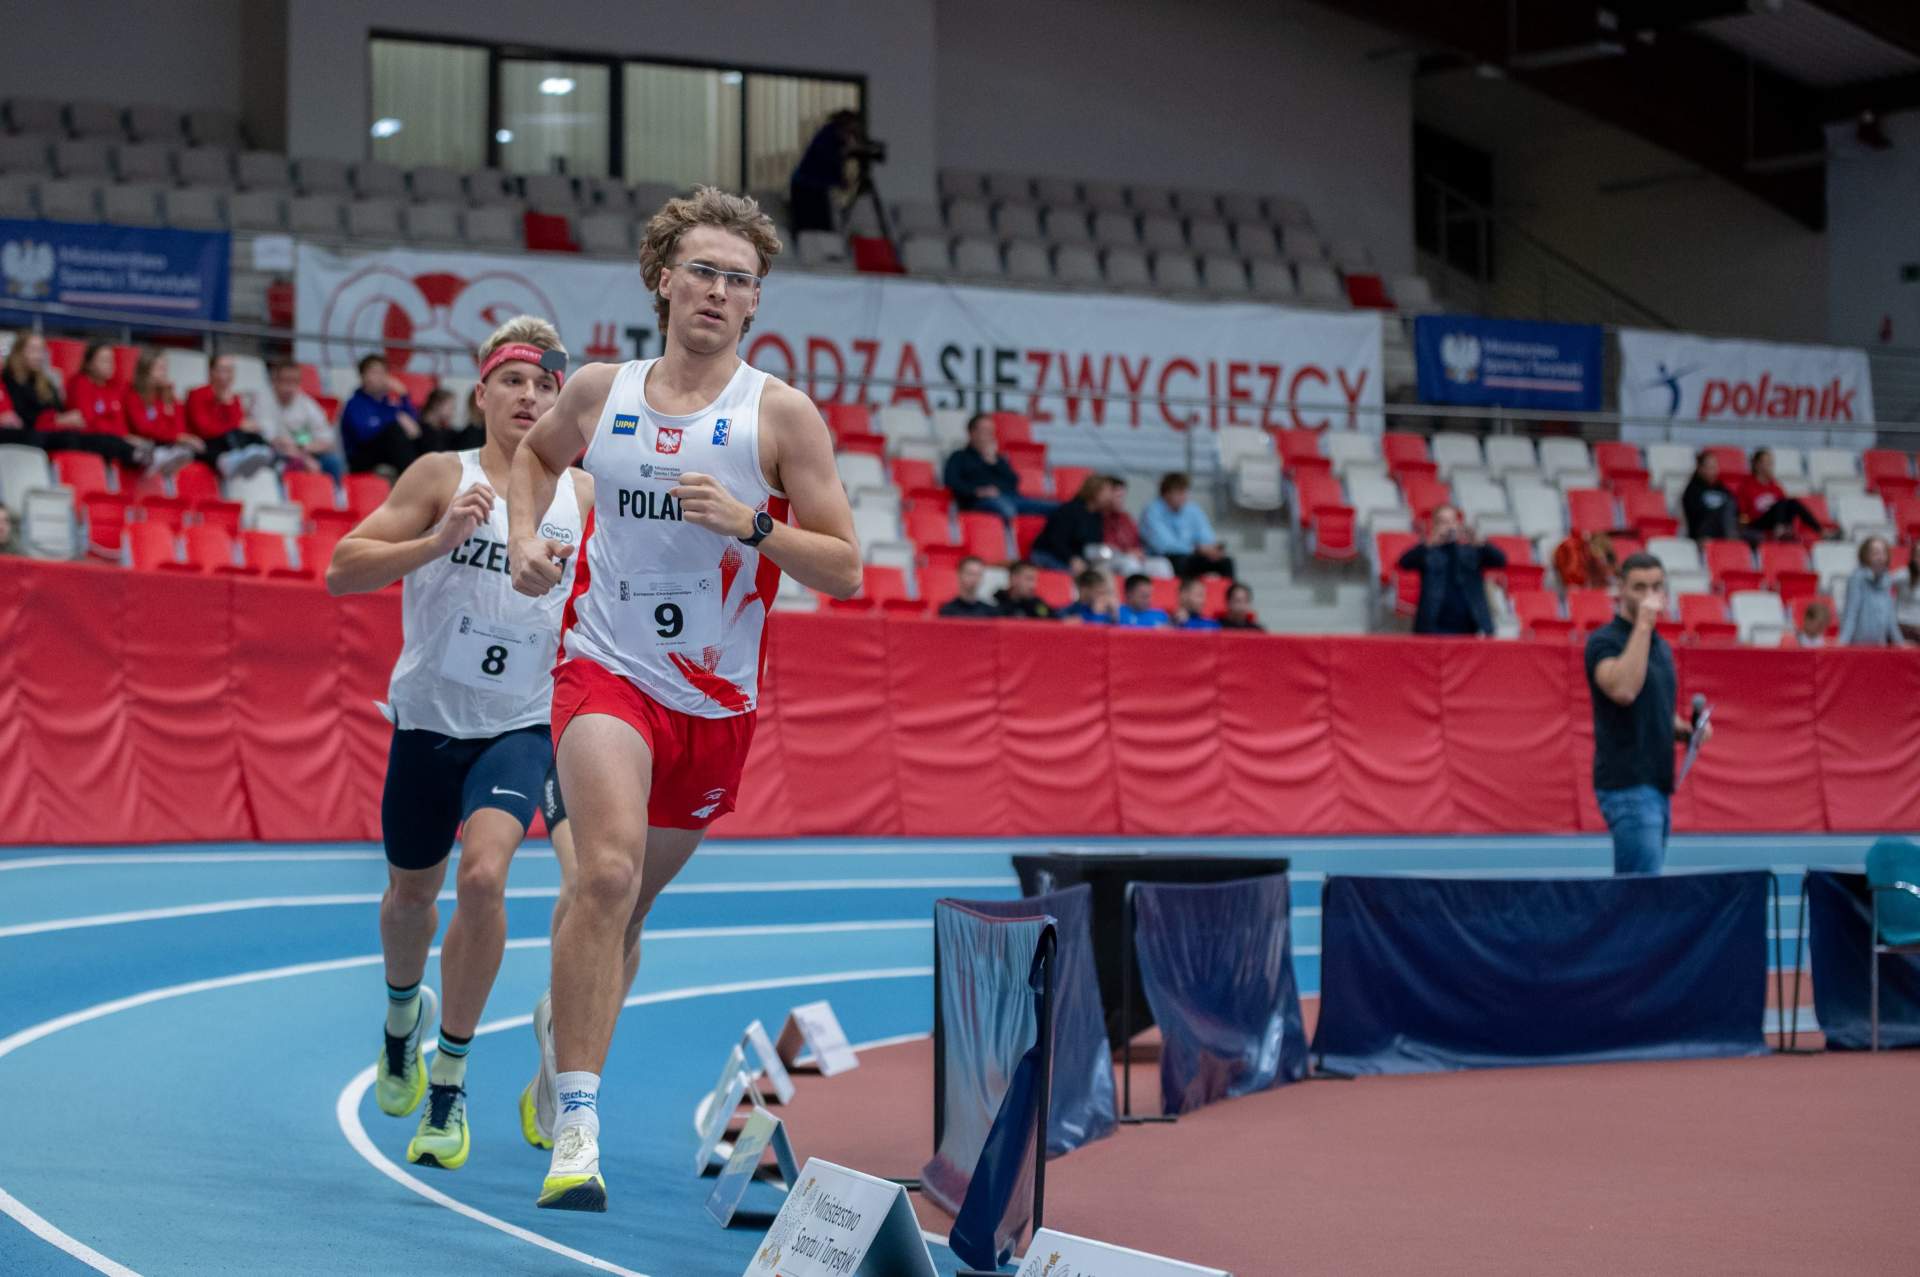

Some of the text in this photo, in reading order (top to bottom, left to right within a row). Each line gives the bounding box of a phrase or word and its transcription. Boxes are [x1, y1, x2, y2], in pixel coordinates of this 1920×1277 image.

[1697, 369, 1857, 423] polanik
[615, 420, 636, 429] UIPM
[654, 602, 684, 638] 9
[481, 645, 508, 676] 8
[810, 1191, 862, 1232] Ministerstwo
[791, 1227, 821, 1258] Sportu
[819, 1238, 861, 1277] Turystyki
